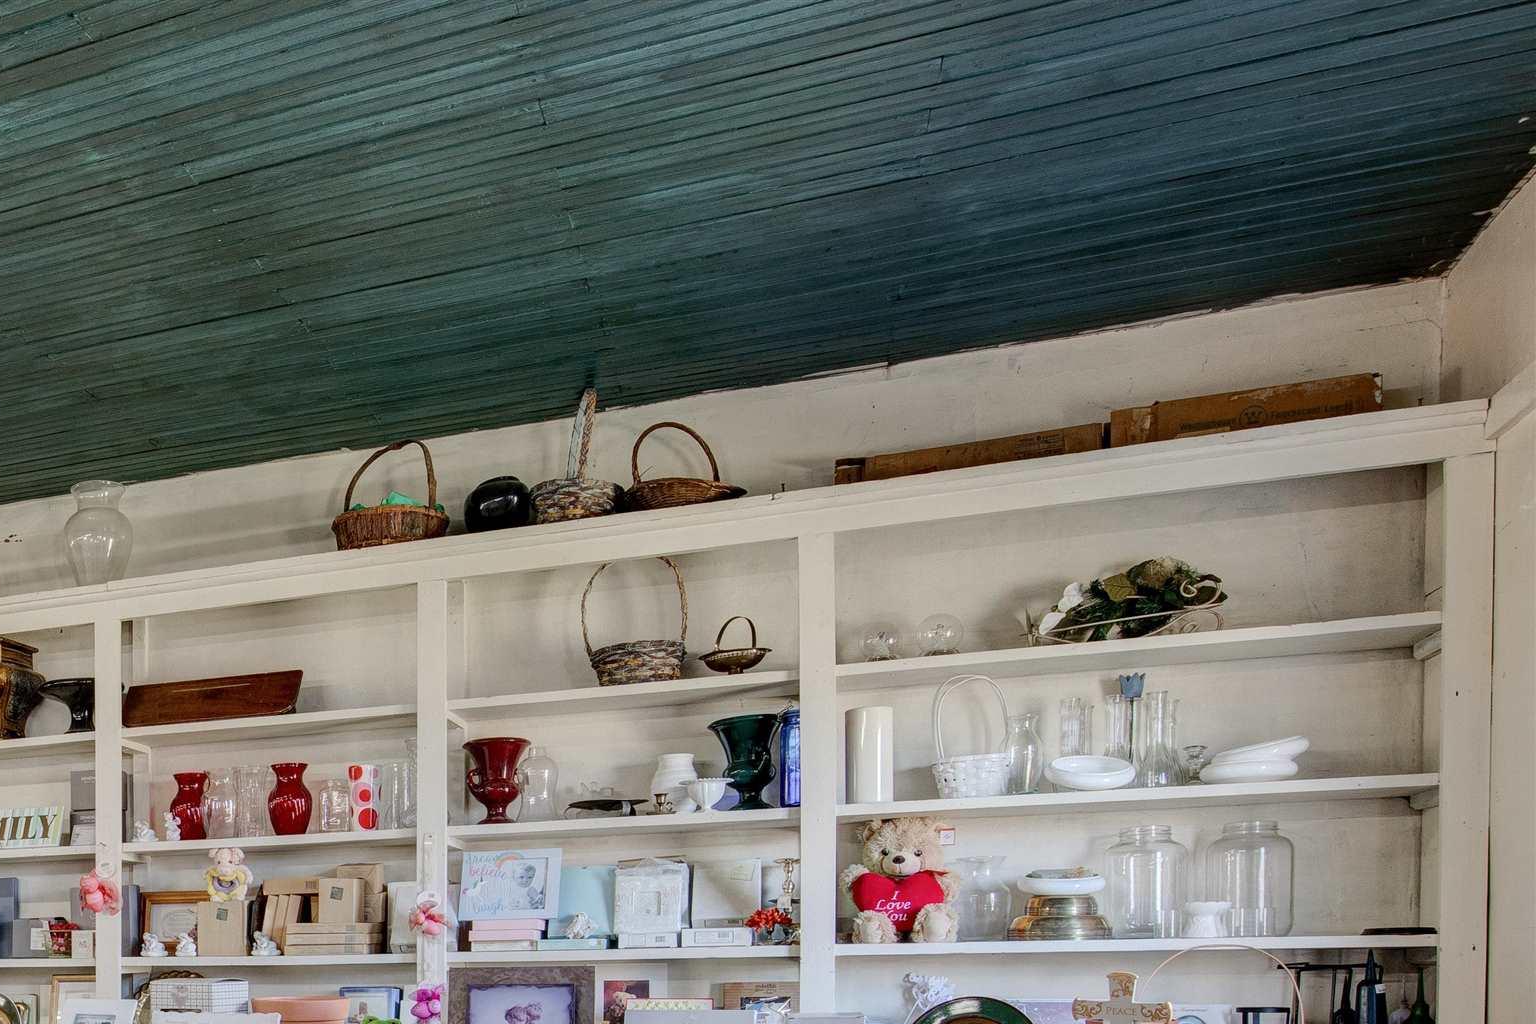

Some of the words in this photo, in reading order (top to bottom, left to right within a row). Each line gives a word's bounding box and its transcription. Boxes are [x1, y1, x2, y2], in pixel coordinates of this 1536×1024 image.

[891, 890, 900, 901] I
[875, 899, 912, 910] Love
[1104, 1006, 1138, 1017] PEACE
